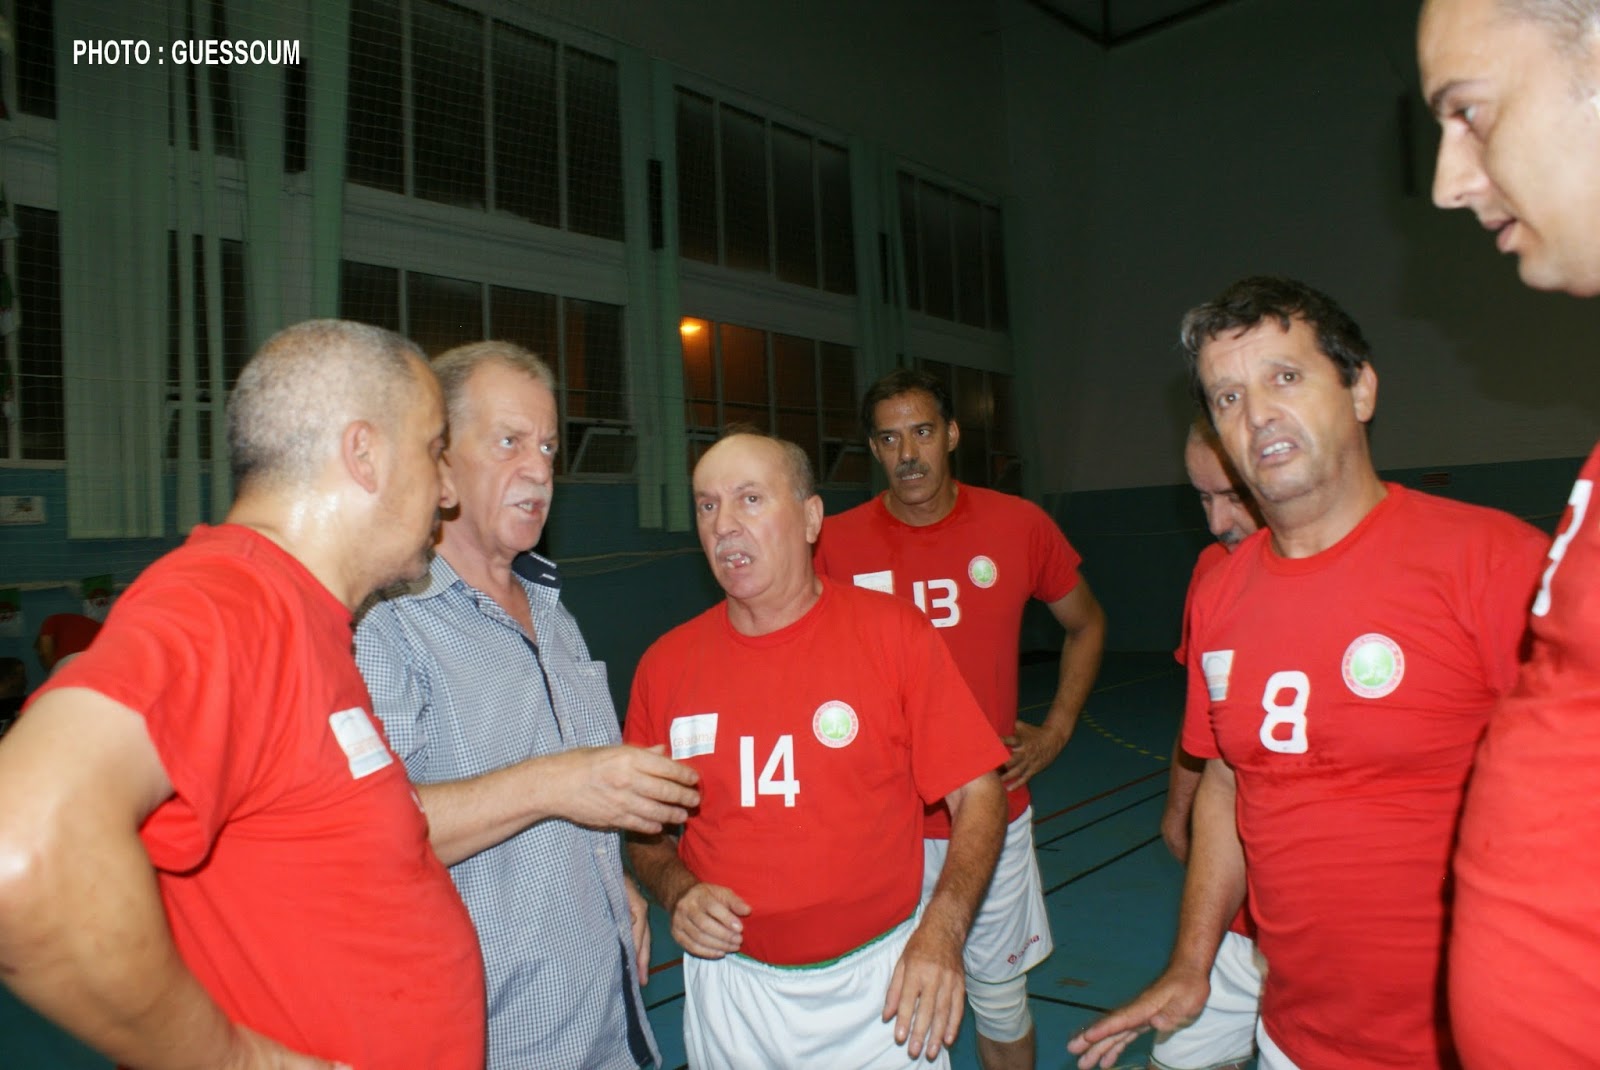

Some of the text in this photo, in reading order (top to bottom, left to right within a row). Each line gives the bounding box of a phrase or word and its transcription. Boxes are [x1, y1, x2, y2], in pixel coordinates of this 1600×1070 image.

[913, 578, 960, 628] 13
[1259, 670, 1310, 754] 8
[739, 734, 800, 807] 14
